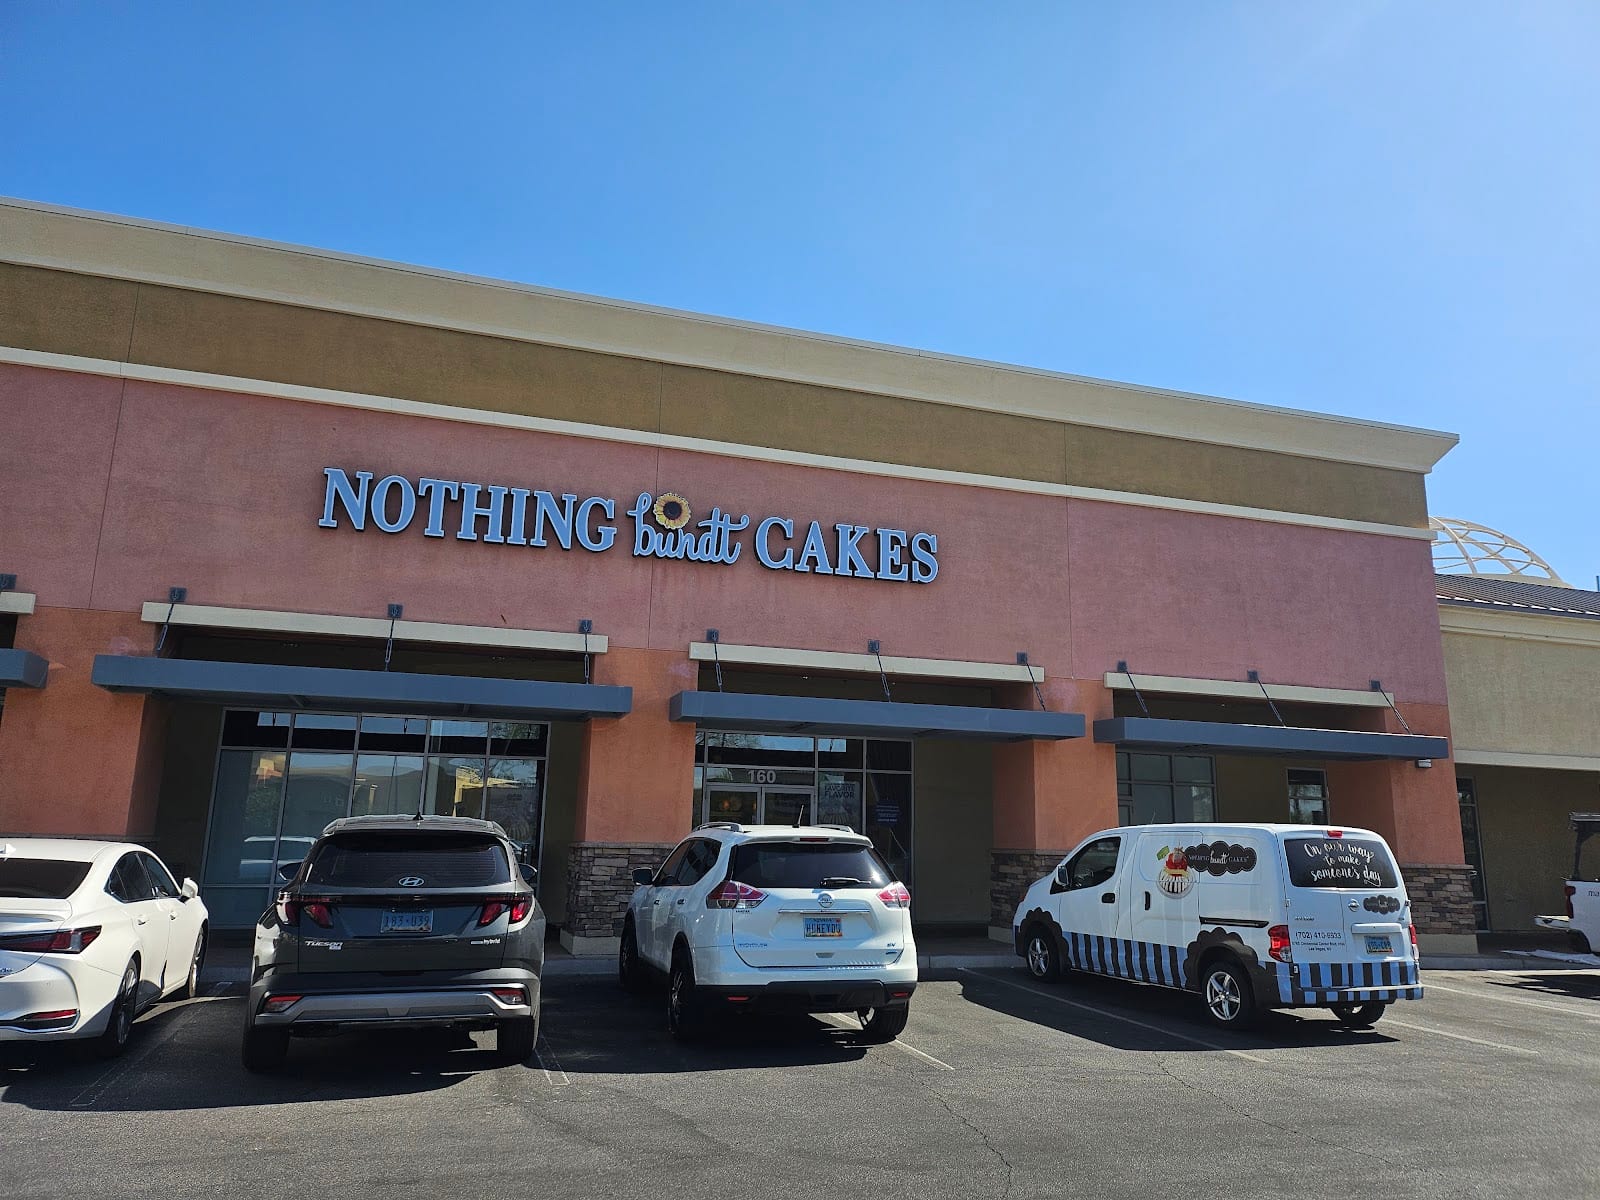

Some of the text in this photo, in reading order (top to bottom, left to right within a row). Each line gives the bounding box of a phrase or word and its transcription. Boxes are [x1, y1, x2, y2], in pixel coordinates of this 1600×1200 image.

[317, 466, 939, 584] NOTHING bundt CAKES
[748, 770, 776, 784] 160
[824, 791, 855, 799] FLAVOR
[1304, 842, 1374, 863] On our way
[1324, 853, 1361, 866] to make
[1311, 866, 1360, 882] someone's
[1295, 931, 1312, 939] (702)
